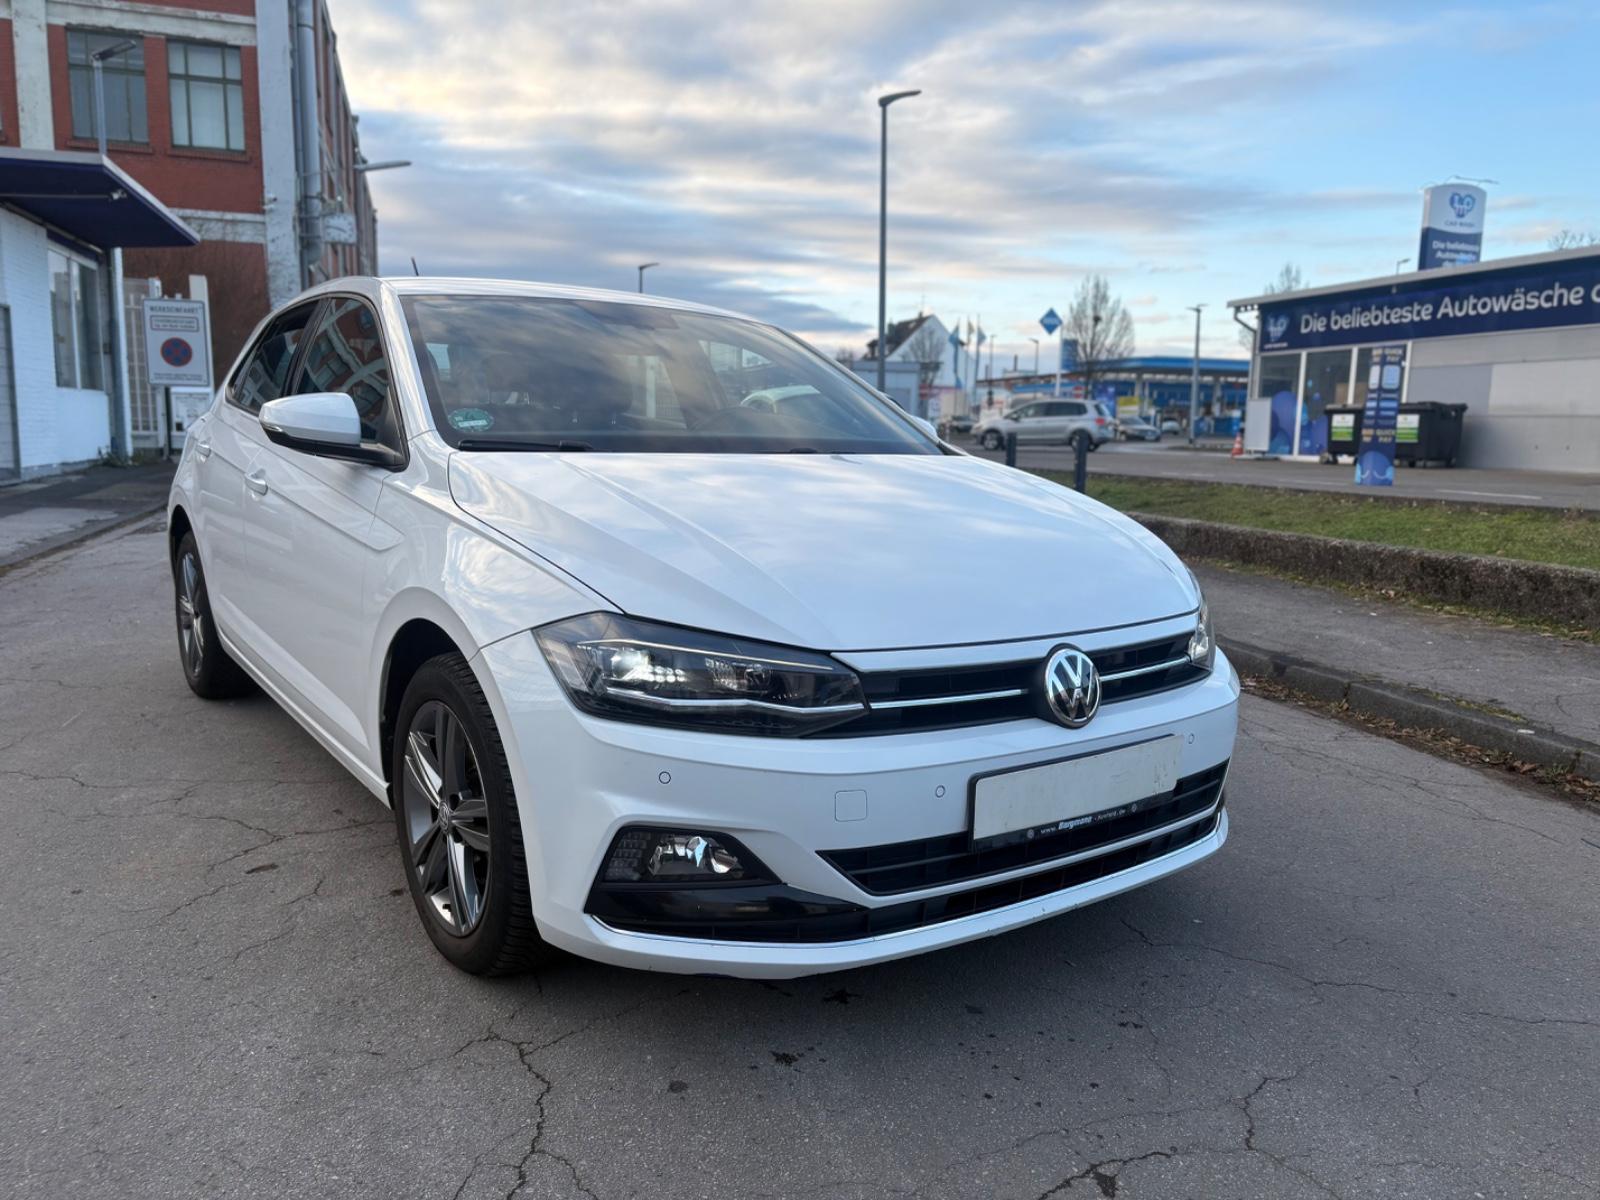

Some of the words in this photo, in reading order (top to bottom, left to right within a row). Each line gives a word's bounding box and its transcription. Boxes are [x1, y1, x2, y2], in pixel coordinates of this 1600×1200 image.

[1432, 240, 1446, 250] Die
[1300, 313, 1328, 334] Die
[1330, 301, 1433, 331] beliebteste
[1436, 281, 1585, 319] Autowäsche
